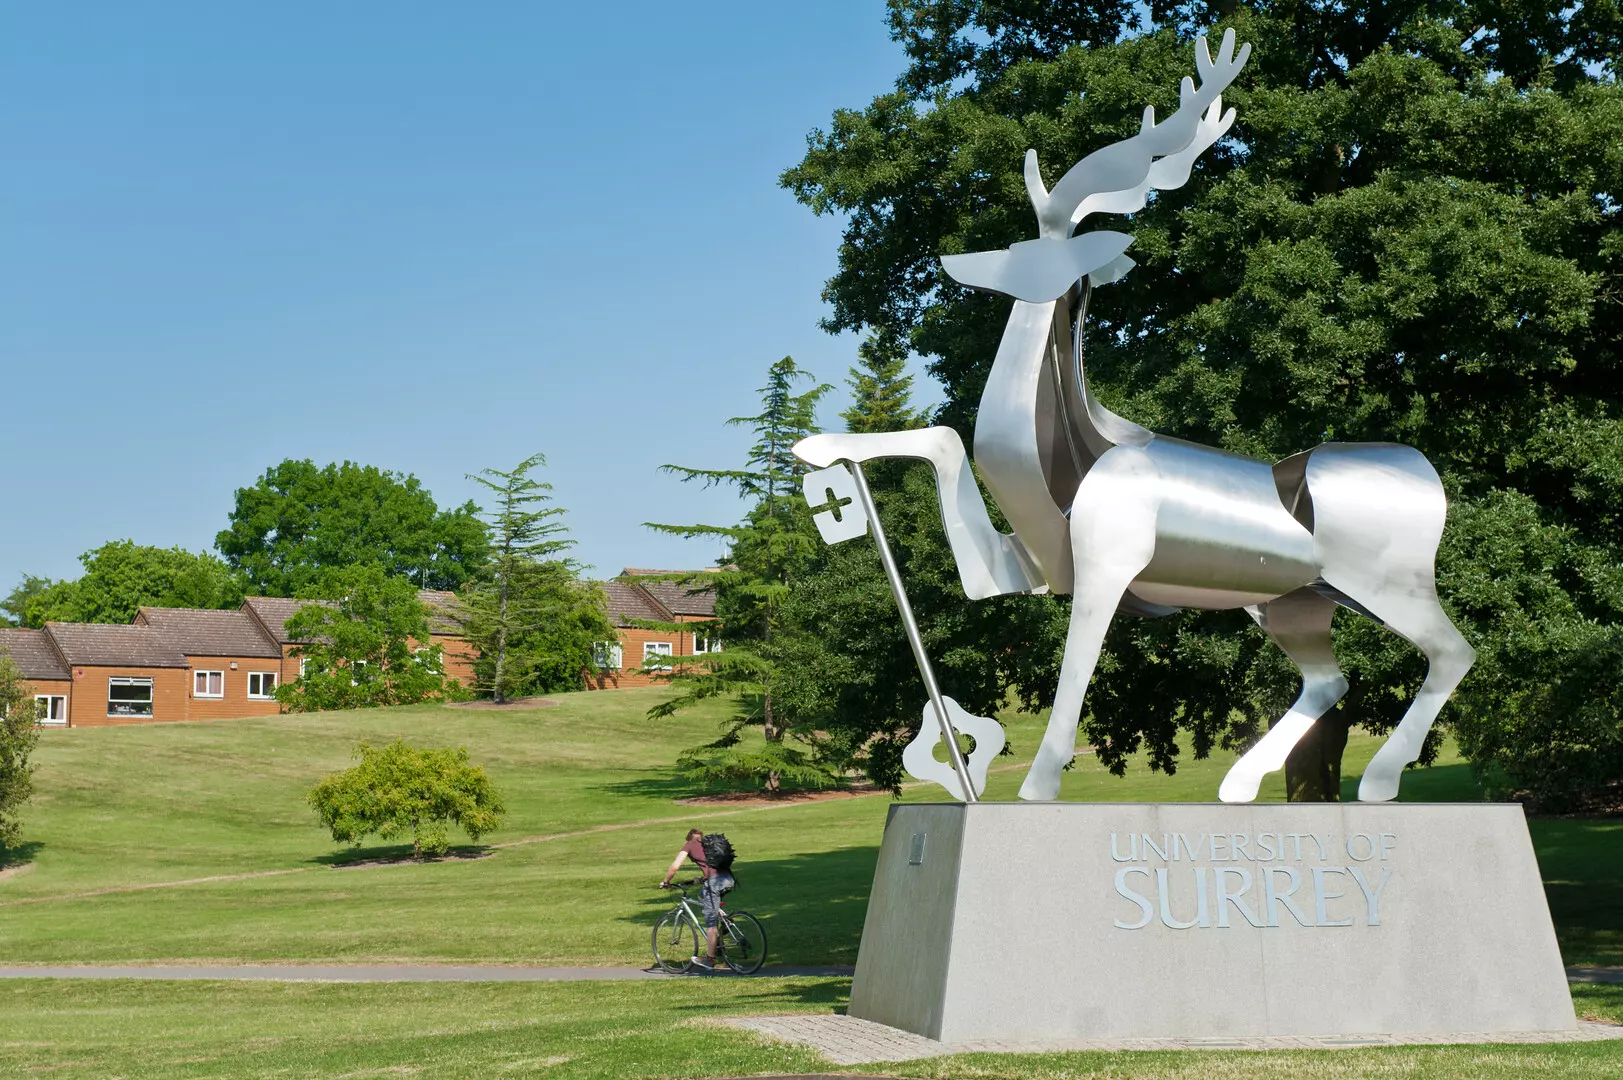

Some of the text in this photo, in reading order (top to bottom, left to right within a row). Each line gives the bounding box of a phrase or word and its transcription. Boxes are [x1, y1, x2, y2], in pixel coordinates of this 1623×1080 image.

[1110, 832, 1397, 862] UNIVERSITY OF
[1113, 866, 1393, 930] SURREY
